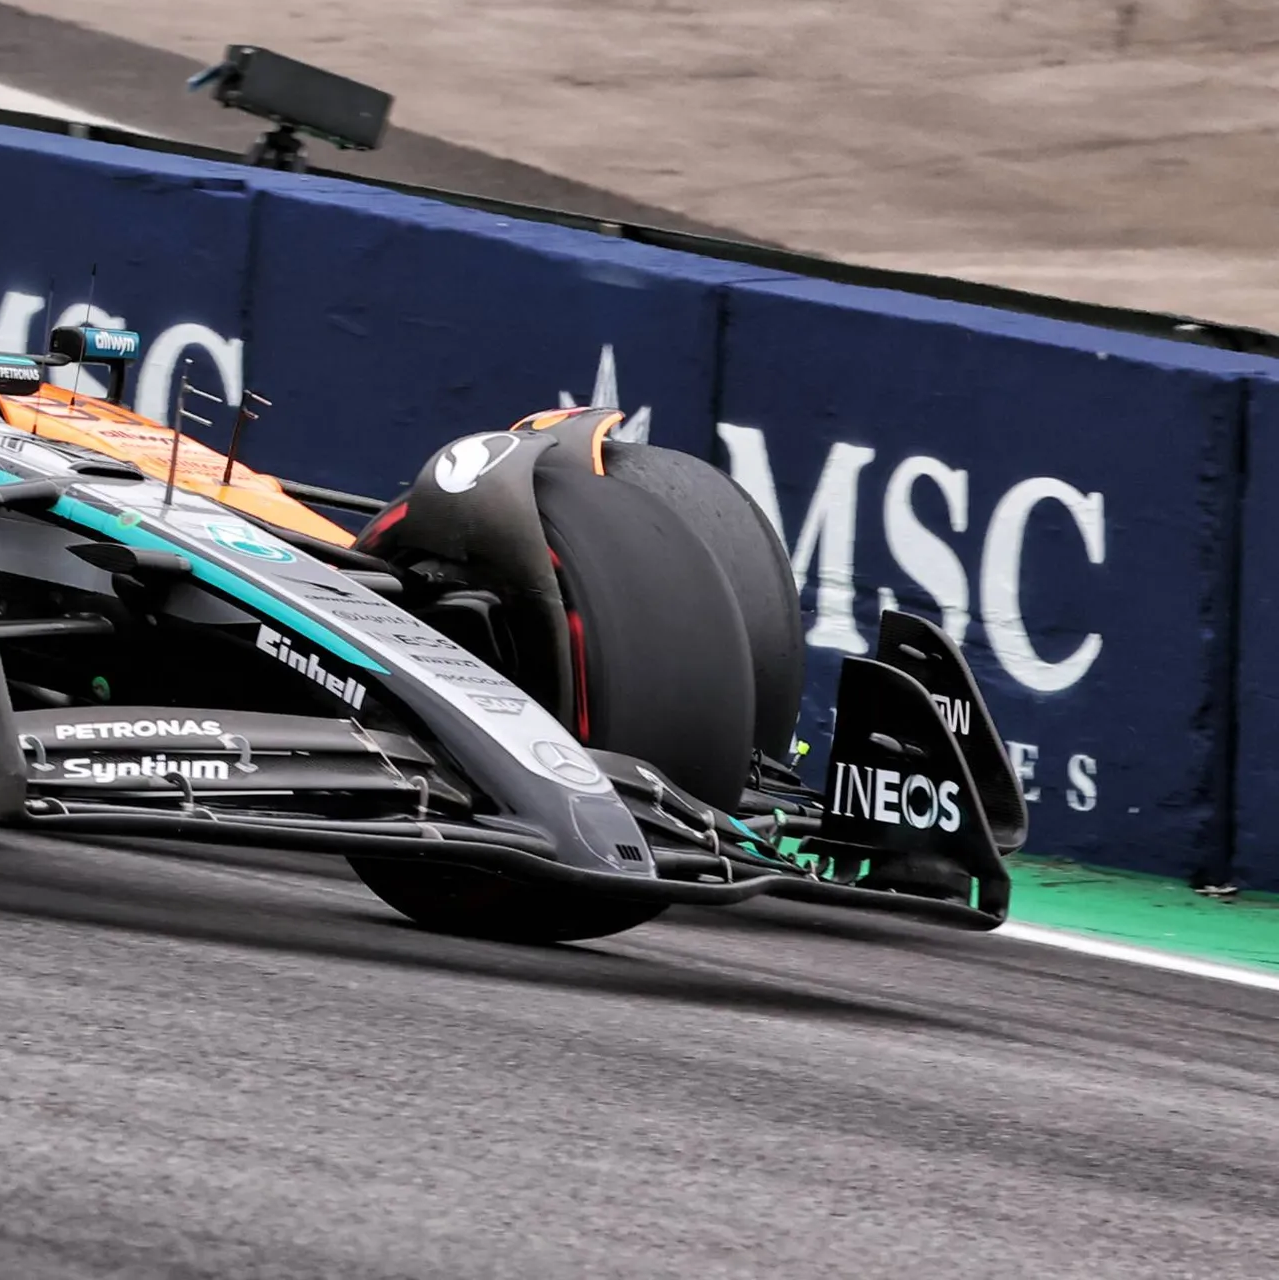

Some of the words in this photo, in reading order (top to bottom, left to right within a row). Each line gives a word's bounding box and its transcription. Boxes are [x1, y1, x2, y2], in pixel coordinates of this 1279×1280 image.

[95, 332, 135, 356] allwyn
[0, 366, 40, 382] PETRONAS
[718, 422, 1105, 692] MSC
[256, 623, 366, 711] Einhell
[56, 718, 222, 740] PETRONAS
[63, 754, 229, 784] Syntium
[831, 762, 961, 832] INEOS
